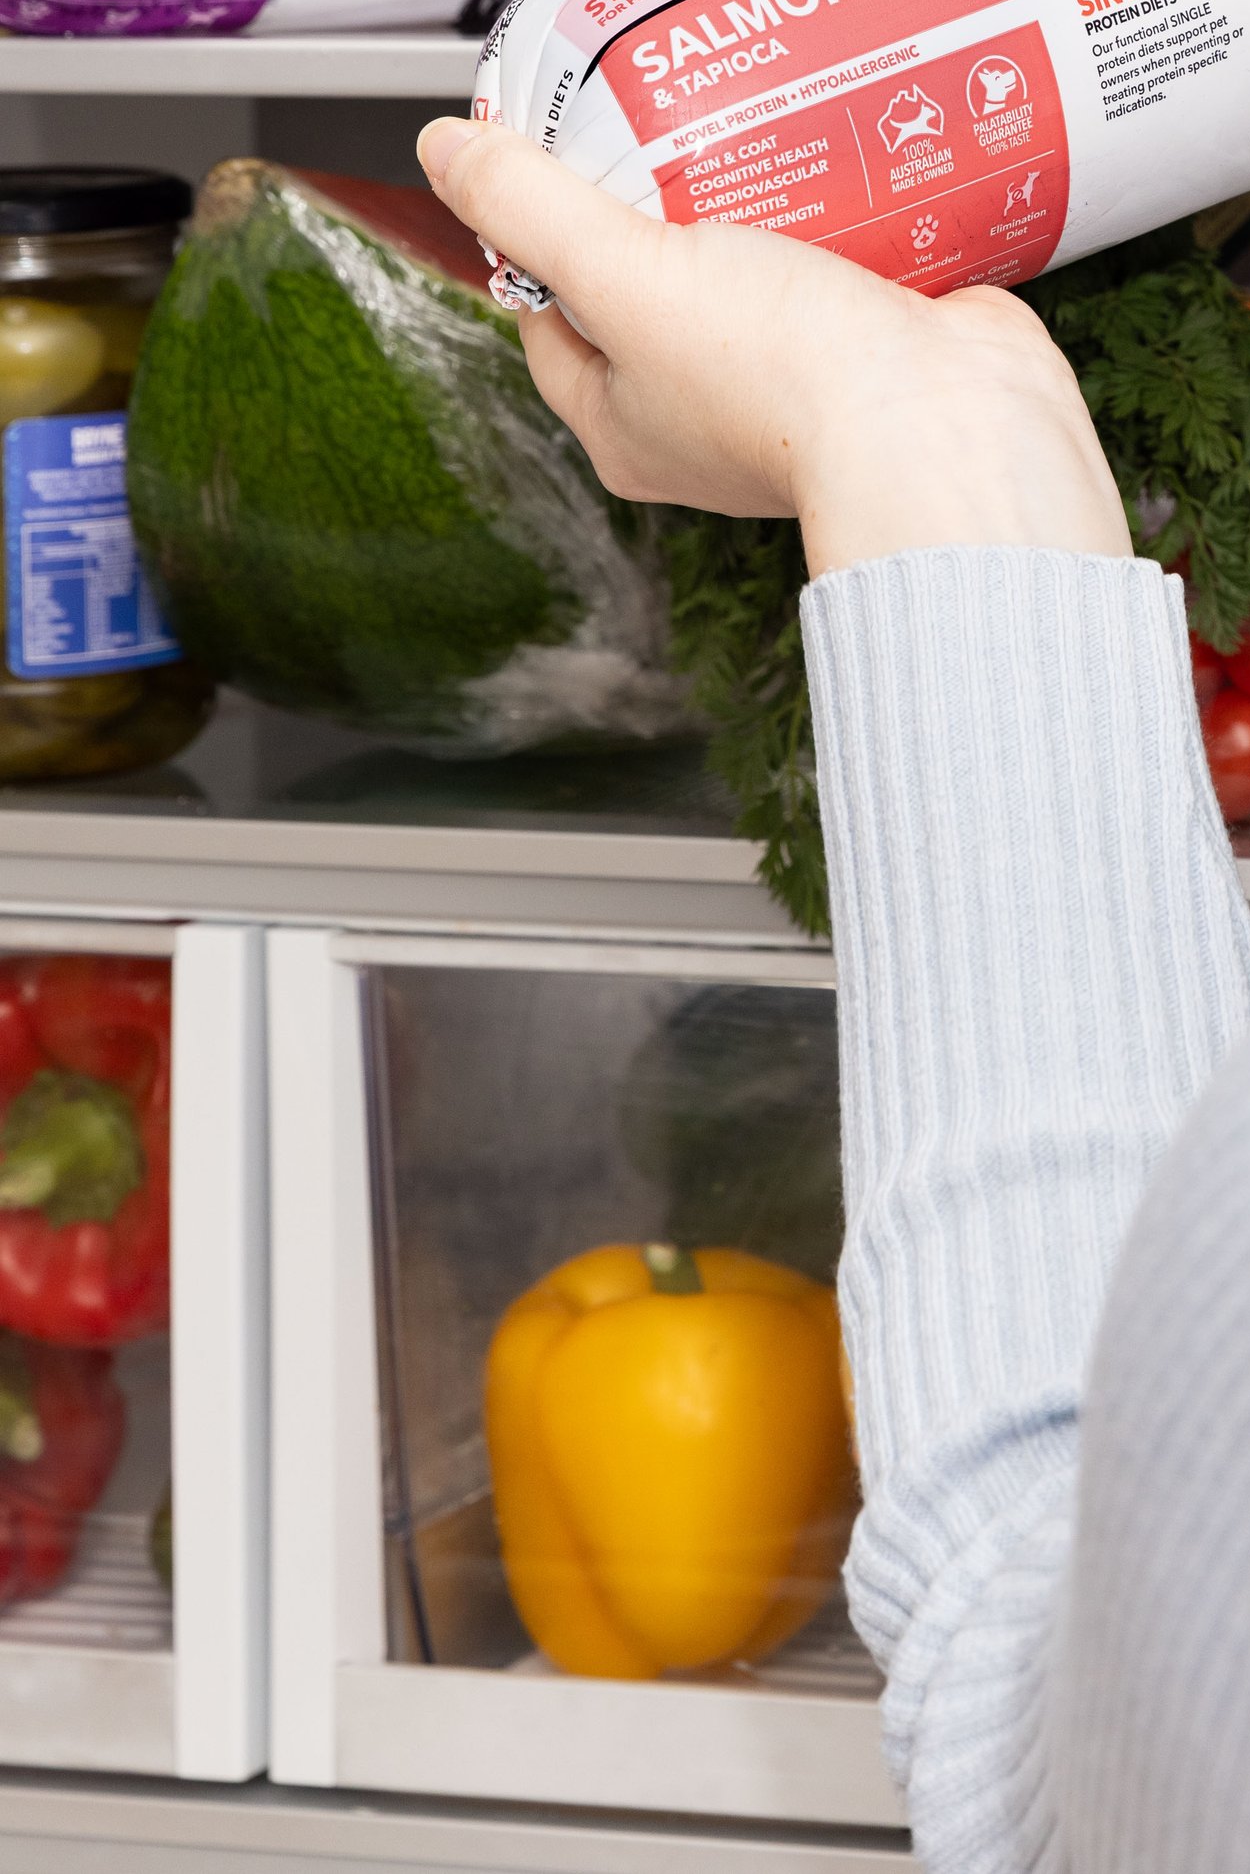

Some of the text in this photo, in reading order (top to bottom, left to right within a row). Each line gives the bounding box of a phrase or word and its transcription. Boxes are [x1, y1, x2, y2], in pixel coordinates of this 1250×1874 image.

[597, 3, 627, 28] FOR
[1085, 4, 1141, 36] PROTEIN
[1092, 2, 1212, 57] Our functional SINGLE
[1096, 15, 1229, 77] protein diets support pet
[1100, 26, 1244, 90] owners when preventing or
[653, 37, 791, 110] & TAPIOCA
[1102, 49, 1228, 105] treating protein specific
[548, 69, 575, 122] DIETS
[672, 44, 921, 151] NOVEL PROTEIN HYPOALLERGENIC
[1105, 91, 1167, 121] indications.
[973, 102, 1034, 136] PALATABILITY
[979, 118, 1033, 147] GUARANTEE
[684, 135, 778, 179] SKIN & COAT
[902, 138, 934, 162] 100%
[986, 132, 1032, 157] 100% TASTE
[689, 137, 829, 197] COGNITIVE HEALTH
[890, 147, 952, 182] AUSTRALIAN
[892, 162, 954, 194] MADE & OWNED
[693, 159, 829, 214] CARDIOVASCULAR
[990, 208, 1048, 236] Elimination
[1006, 226, 1029, 241] Diet
[890, 251, 962, 283] commended
[915, 253, 933, 265] Vet
[967, 258, 1020, 284] No Grain
